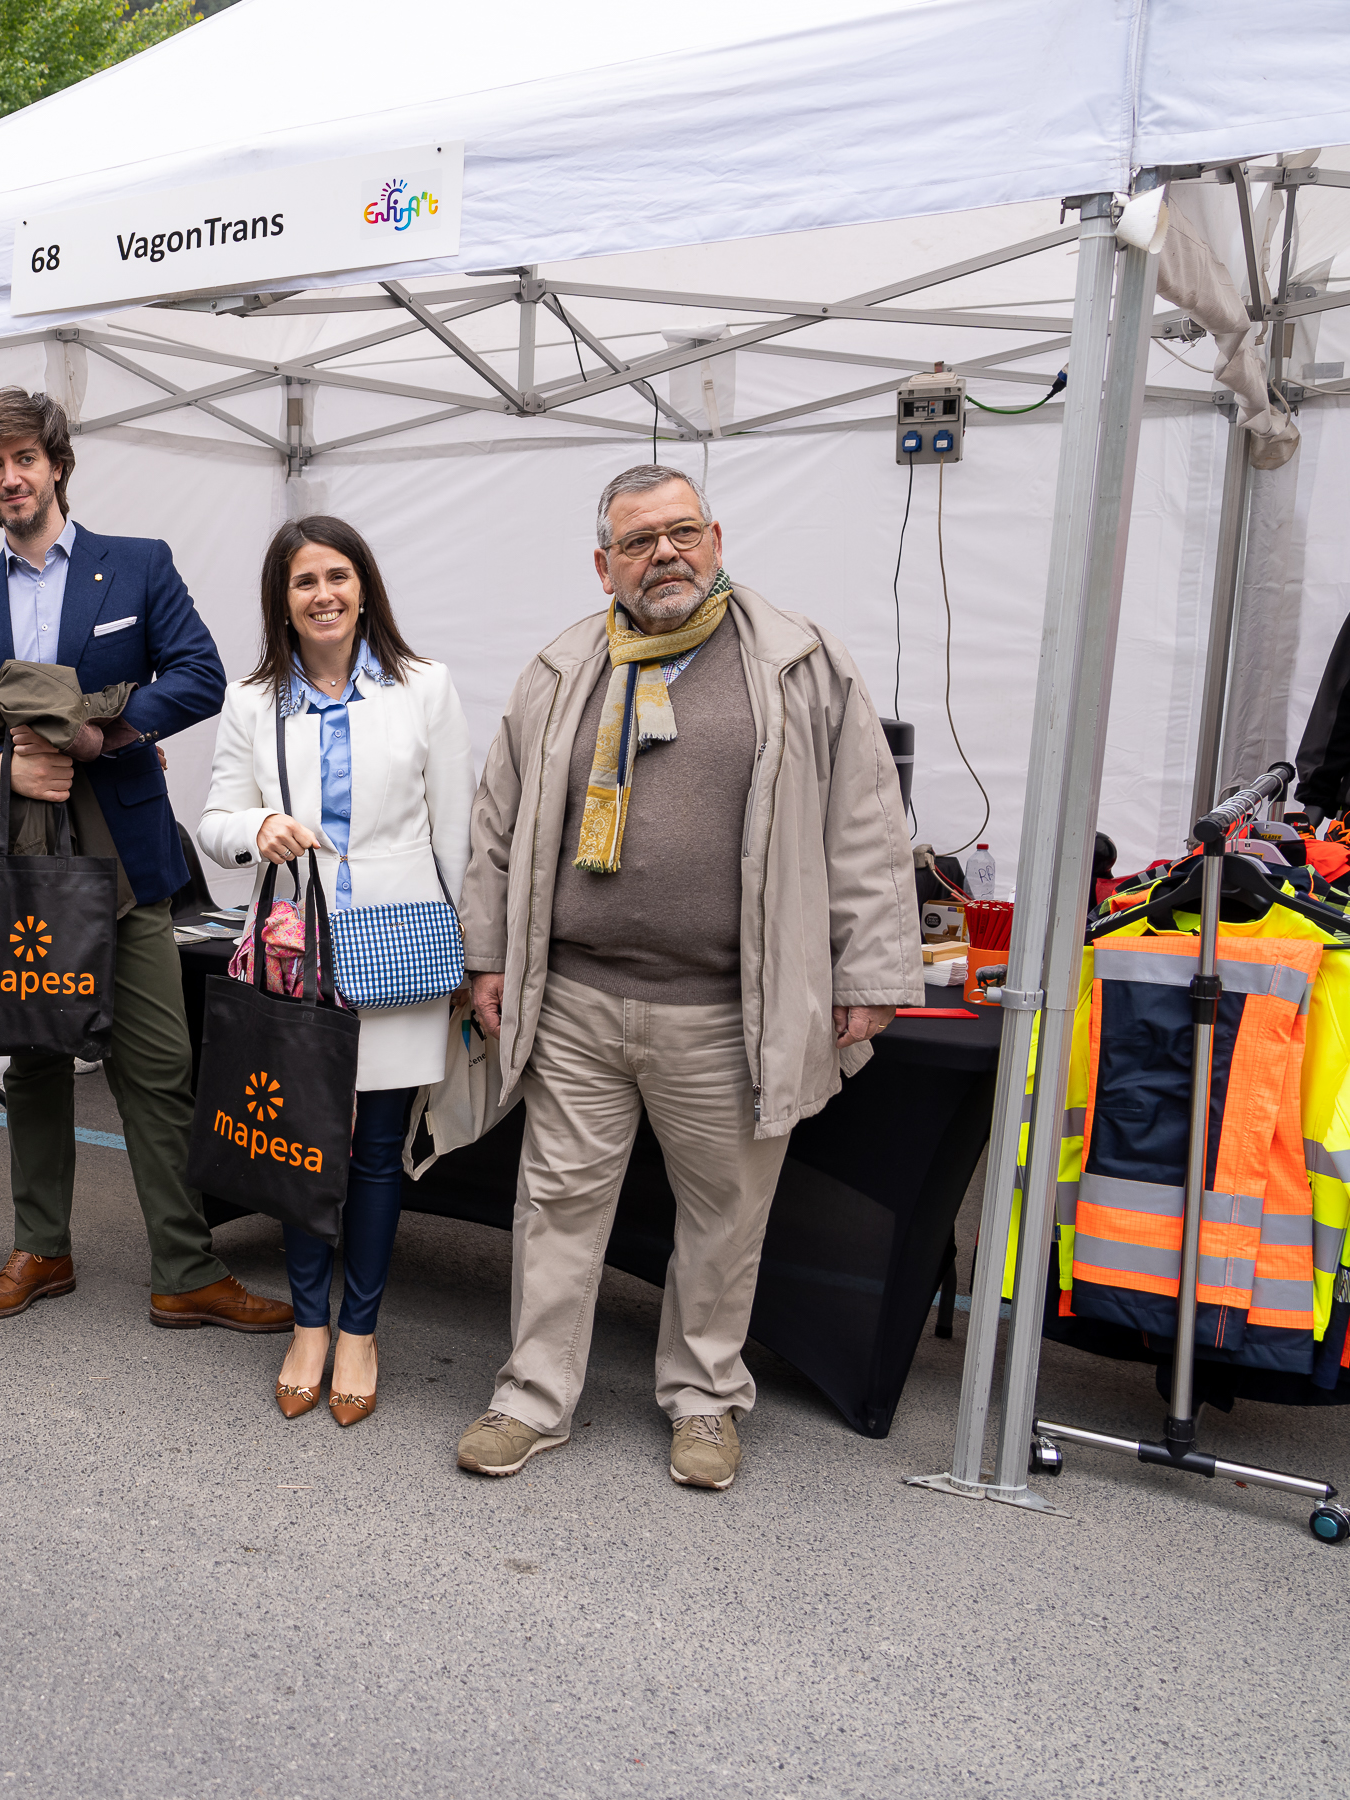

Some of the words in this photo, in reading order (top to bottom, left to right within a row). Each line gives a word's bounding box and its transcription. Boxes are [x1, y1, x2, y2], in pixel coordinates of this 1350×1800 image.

[31, 243, 61, 273] 68
[116, 213, 284, 263] VagonTrans
[213, 1109, 323, 1173] mapesa
